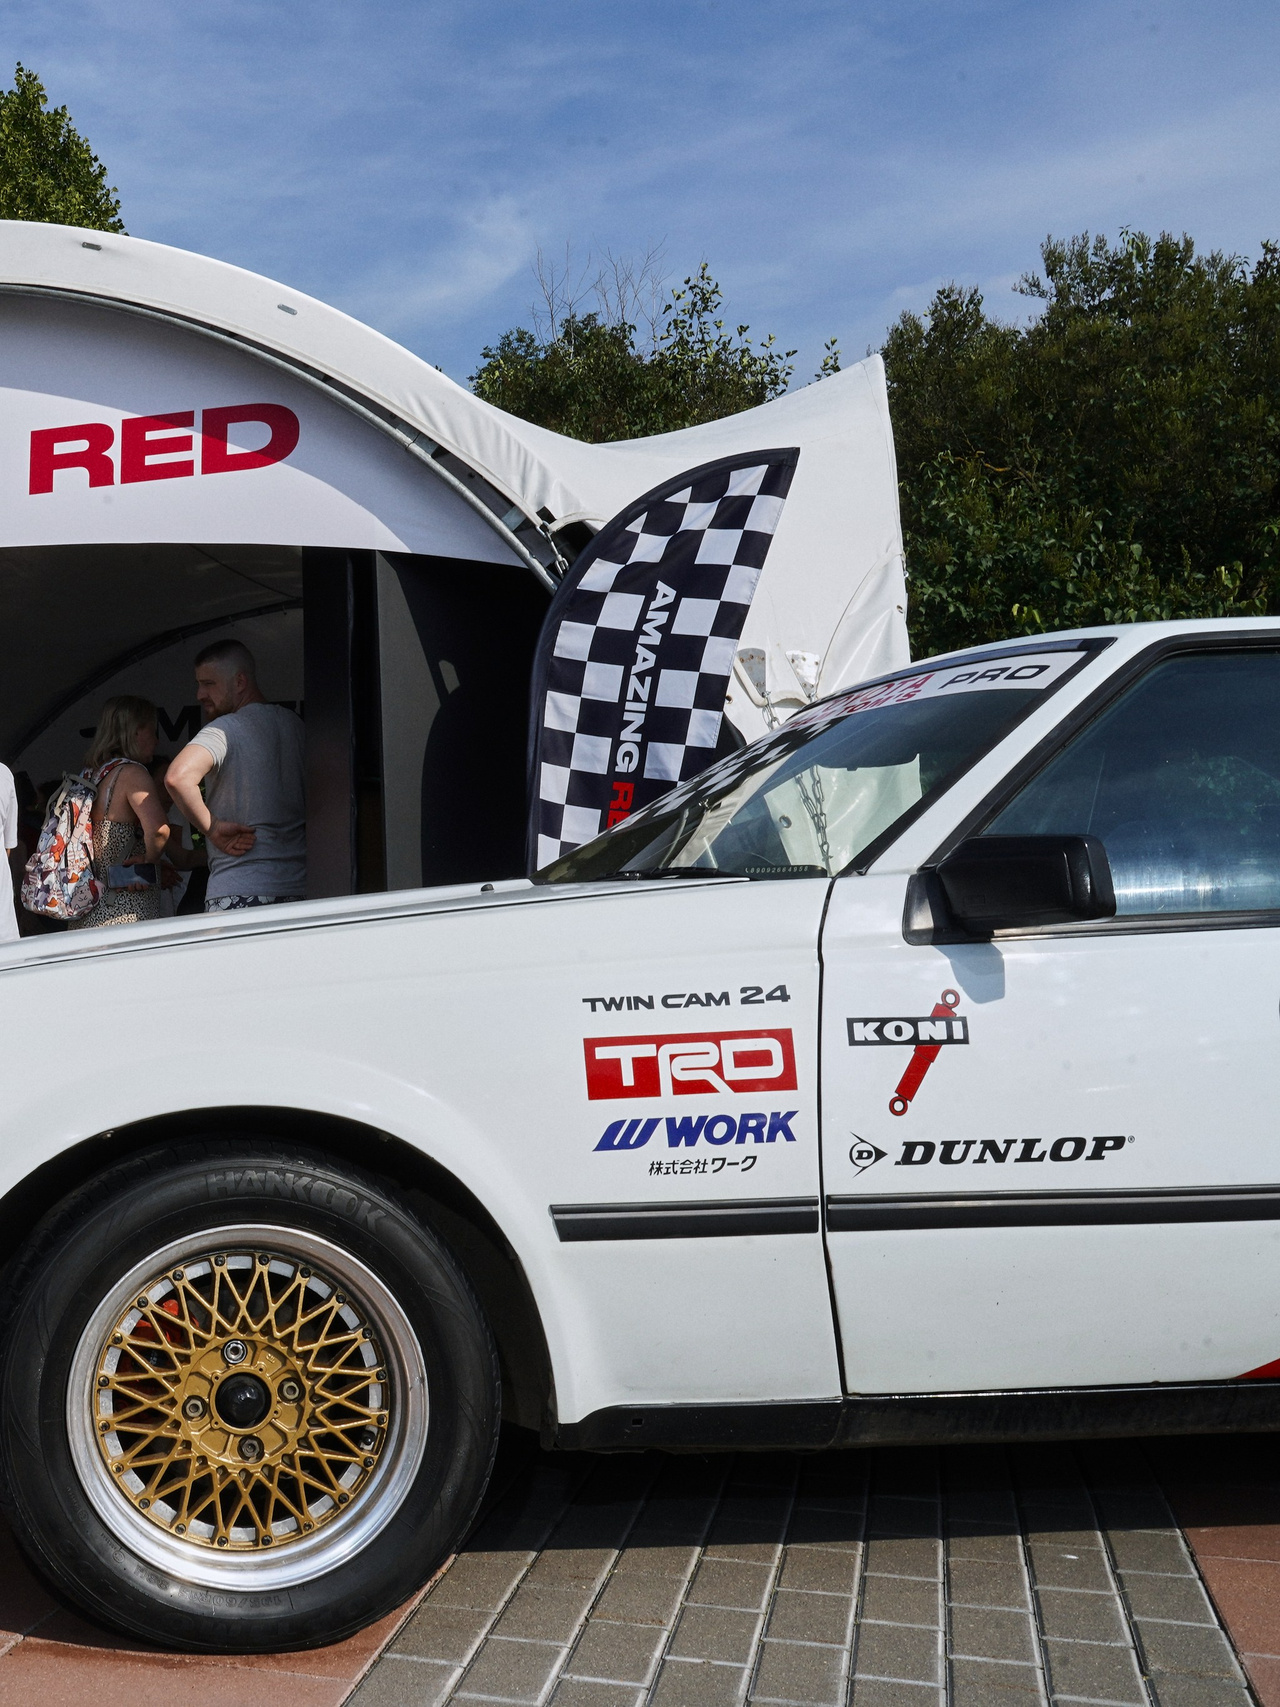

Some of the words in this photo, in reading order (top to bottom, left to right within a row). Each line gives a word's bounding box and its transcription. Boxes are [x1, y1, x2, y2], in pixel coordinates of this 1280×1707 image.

[28, 402, 300, 495] RED
[615, 580, 677, 774] AMAZING
[818, 673, 936, 713] OYOTA
[939, 664, 1051, 689] PRO
[606, 781, 635, 830] RE
[582, 995, 655, 1012] TWIN
[661, 991, 731, 1009] CAM
[740, 984, 791, 1005] 24
[853, 1020, 965, 1042] KONI
[595, 1037, 784, 1097] TRD
[665, 1110, 799, 1148] WORK
[649, 1155, 758, 1176] 株式会社ワーク
[206, 1170, 387, 1234] HANKOOK
